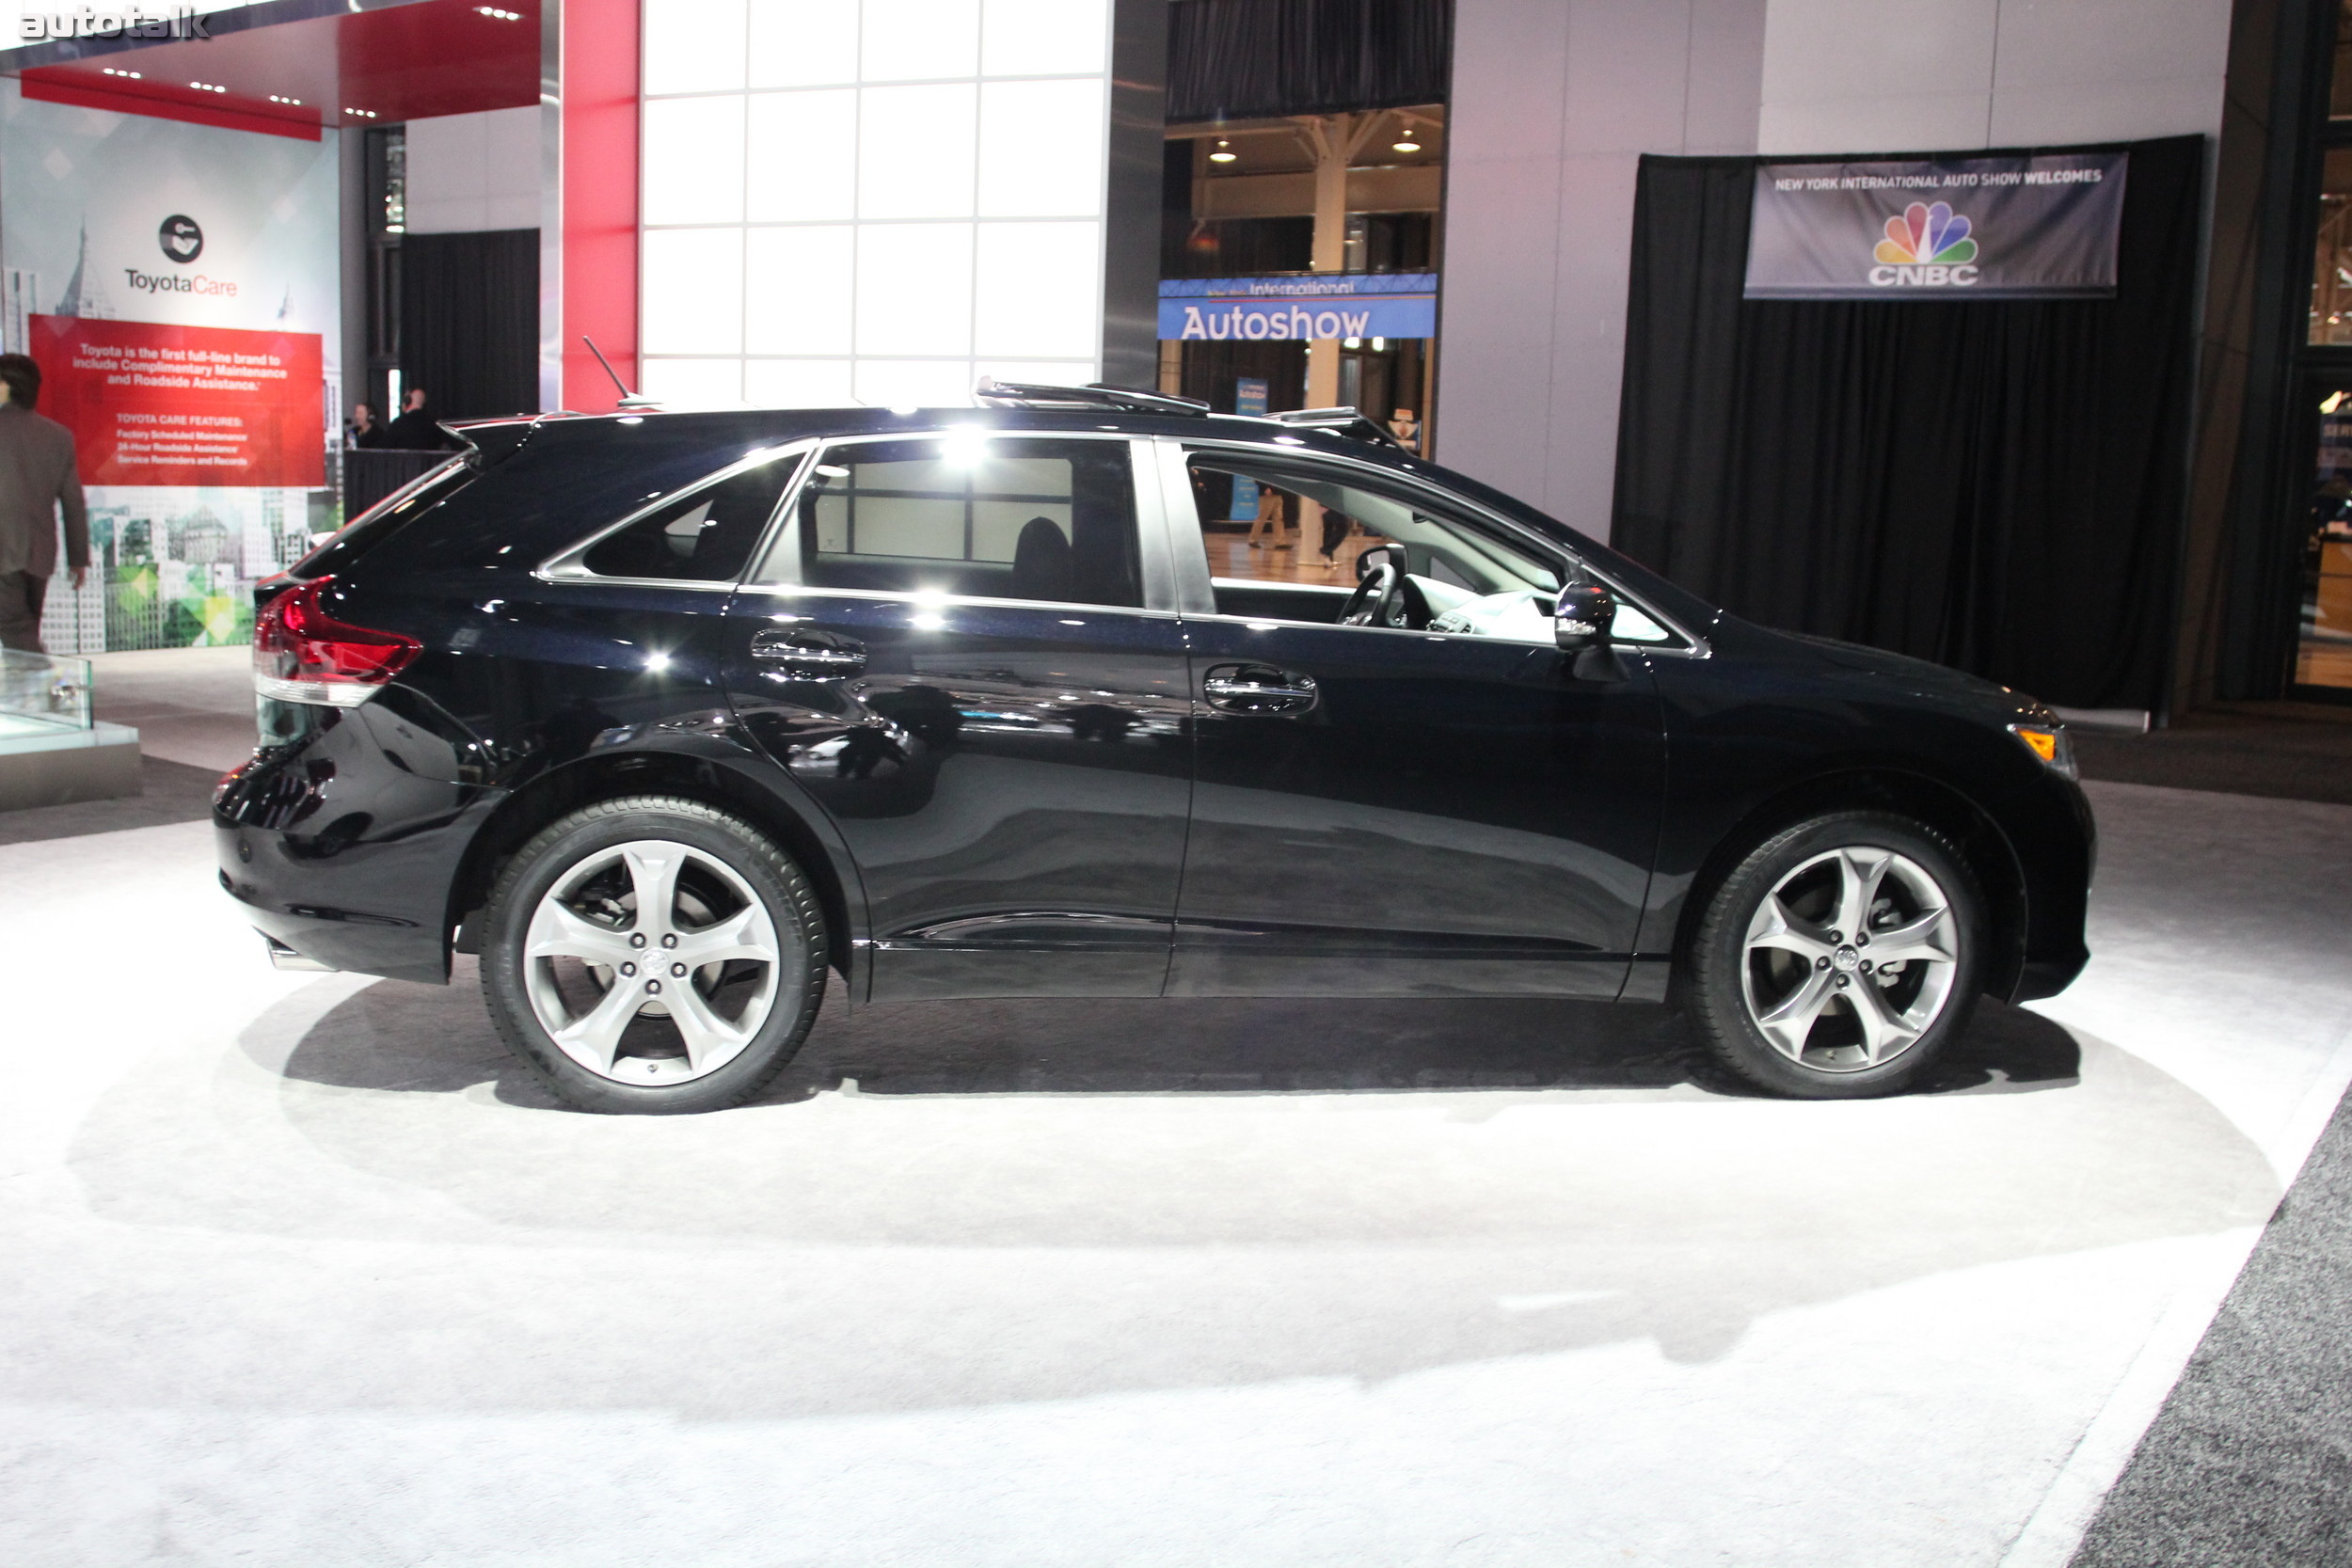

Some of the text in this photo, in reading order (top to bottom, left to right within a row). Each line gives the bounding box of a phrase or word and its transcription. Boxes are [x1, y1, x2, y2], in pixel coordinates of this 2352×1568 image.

[1775, 169, 2103, 190] NEW YORK INTERNATIONAL AUTO SHOW WELCOMES
[125, 268, 237, 297] ToyotaCare
[1249, 280, 1355, 294] International
[1868, 266, 1979, 287] CNBC
[1182, 304, 1370, 340] Autoshow
[80, 342, 280, 366] Toyota is the first full-line brand to
[72, 356, 287, 379] include Complimentary Maintenance
[107, 374, 131, 386] and
[134, 373, 190, 388] Roadside
[117, 413, 157, 424] TOYOTA
[159, 415, 187, 425] CARE
